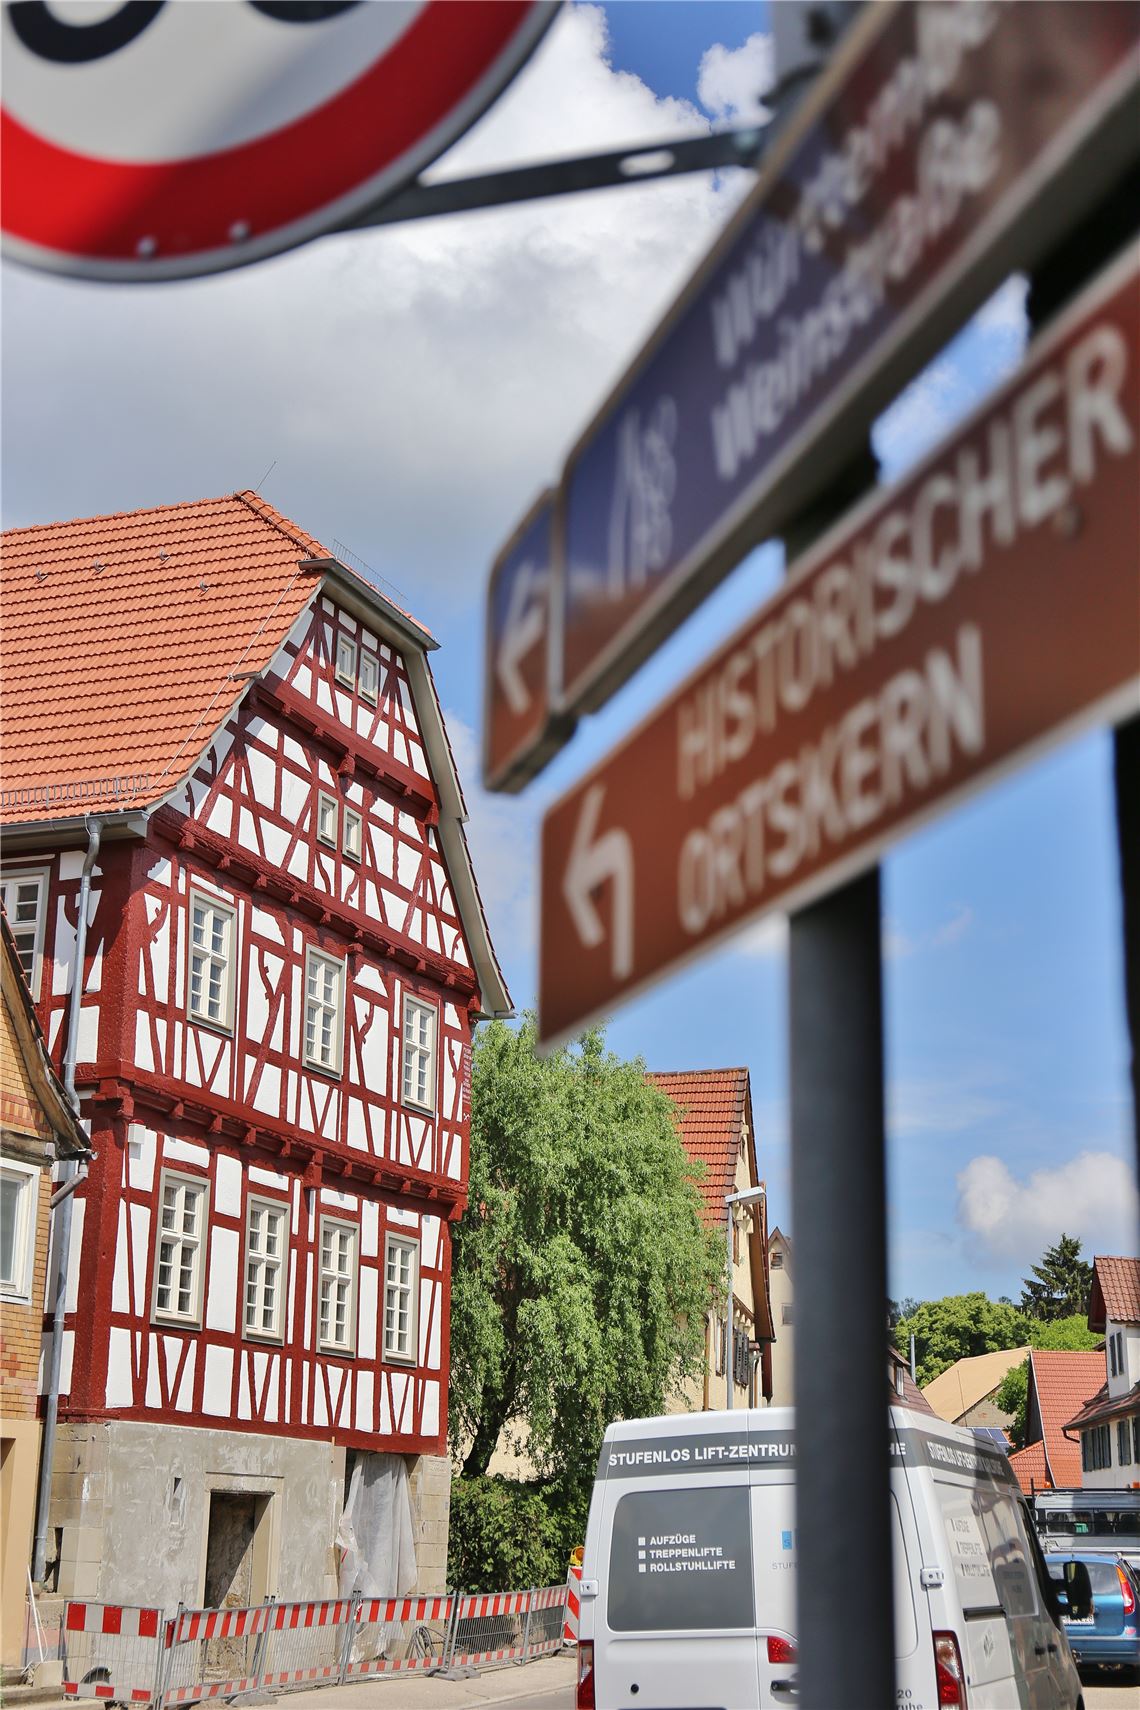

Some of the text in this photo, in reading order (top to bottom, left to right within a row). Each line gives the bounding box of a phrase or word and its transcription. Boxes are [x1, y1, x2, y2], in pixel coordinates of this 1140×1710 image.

[677, 323, 1133, 800] HISTORISCHER
[678, 622, 985, 936] ORTSKERN
[608, 1448, 691, 1467] STUFENLOS
[650, 1533, 696, 1546] AUFZÜGE
[650, 1547, 723, 1559] TREPPENLIFTE
[650, 1560, 736, 1573] ROLLSTUHLLIFTE
